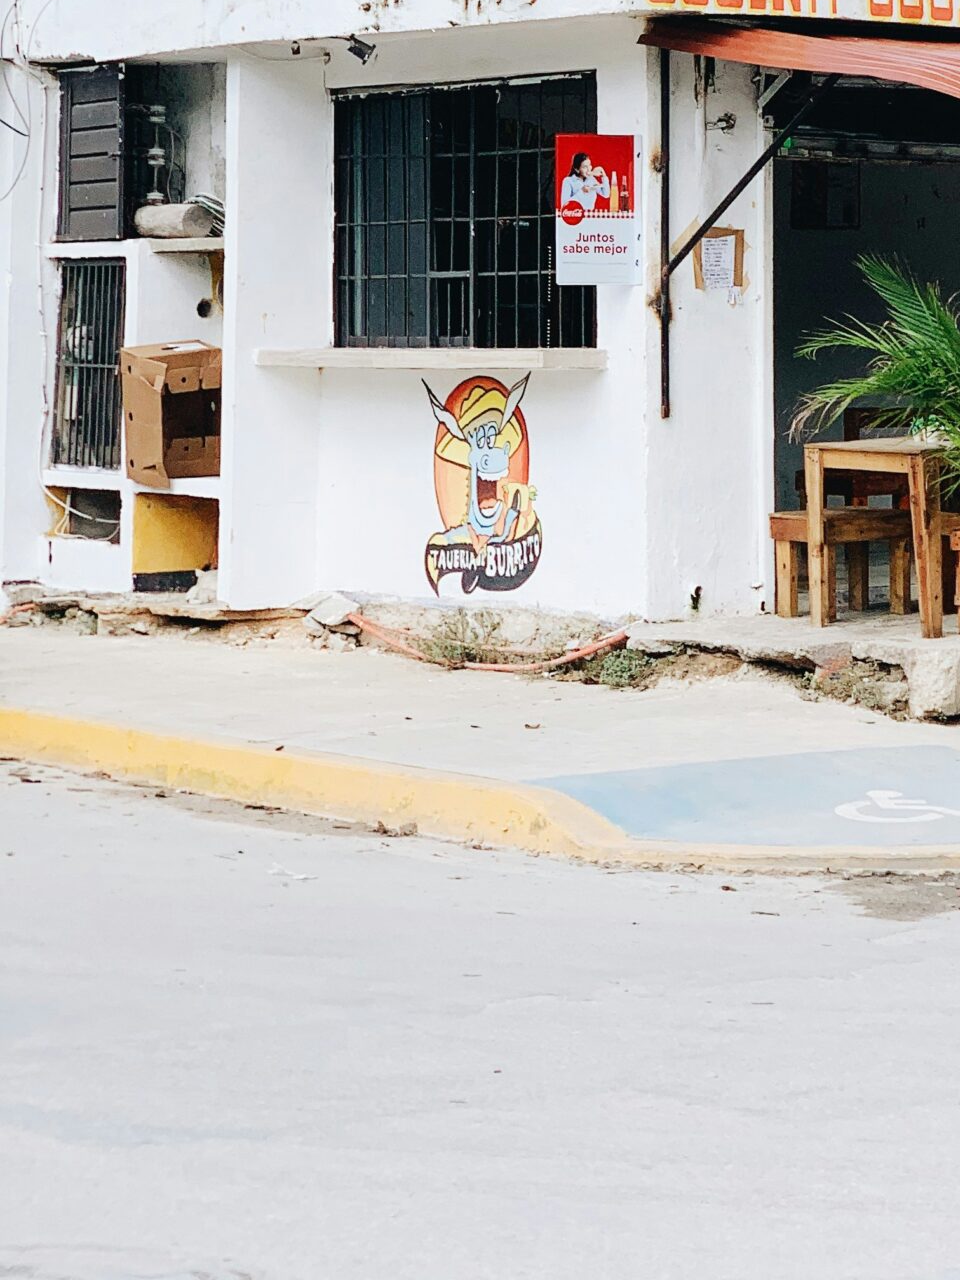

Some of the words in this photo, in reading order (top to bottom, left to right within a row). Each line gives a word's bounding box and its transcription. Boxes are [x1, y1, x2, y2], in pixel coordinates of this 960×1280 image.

[576, 232, 614, 243] Juntos
[563, 244, 590, 254] sabe
[594, 244, 628, 256] mejor
[485, 535, 540, 577] BURRITO
